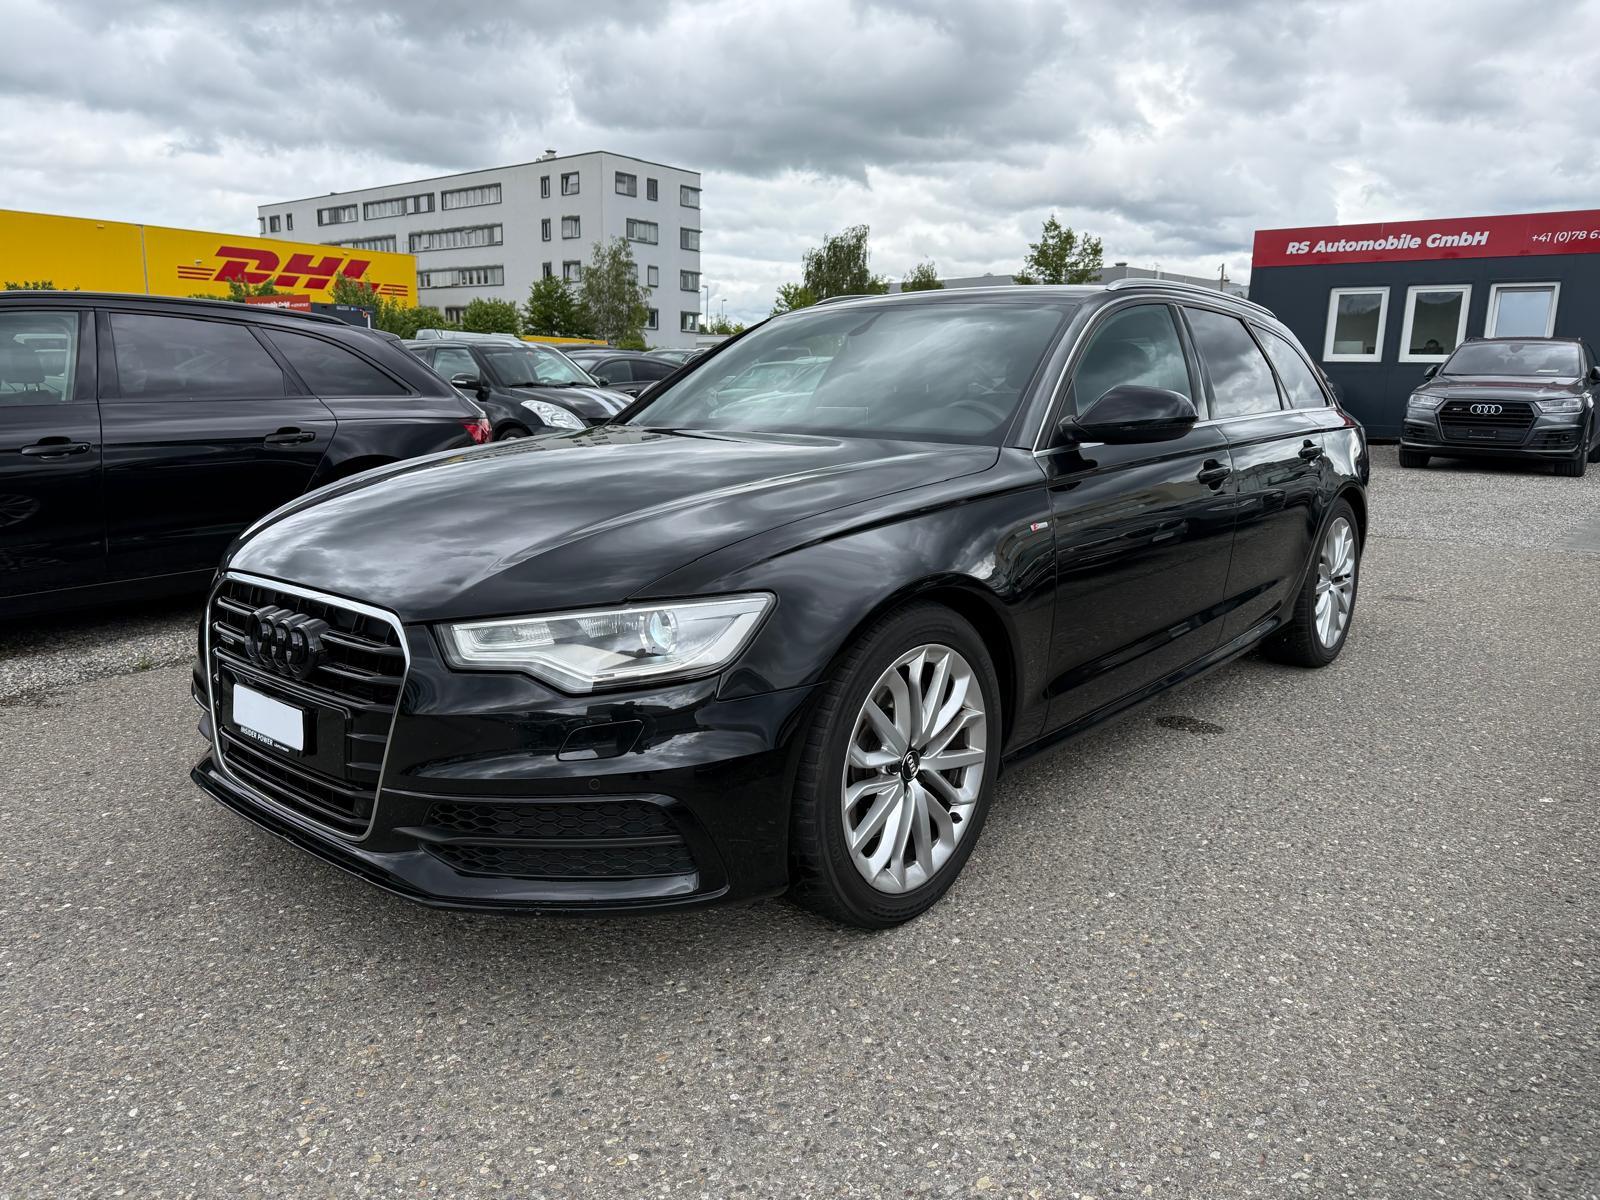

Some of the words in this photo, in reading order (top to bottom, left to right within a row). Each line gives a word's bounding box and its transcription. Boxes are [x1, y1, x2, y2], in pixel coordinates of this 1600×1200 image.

[1285, 241, 1310, 255] RS
[1312, 233, 1422, 254] Automobile
[1426, 231, 1490, 248] GmbH
[1531, 232, 1553, 242] +41
[1553, 230, 1588, 244] (0)78
[1589, 229, 1600, 239] 6
[213, 246, 381, 293] DHL
